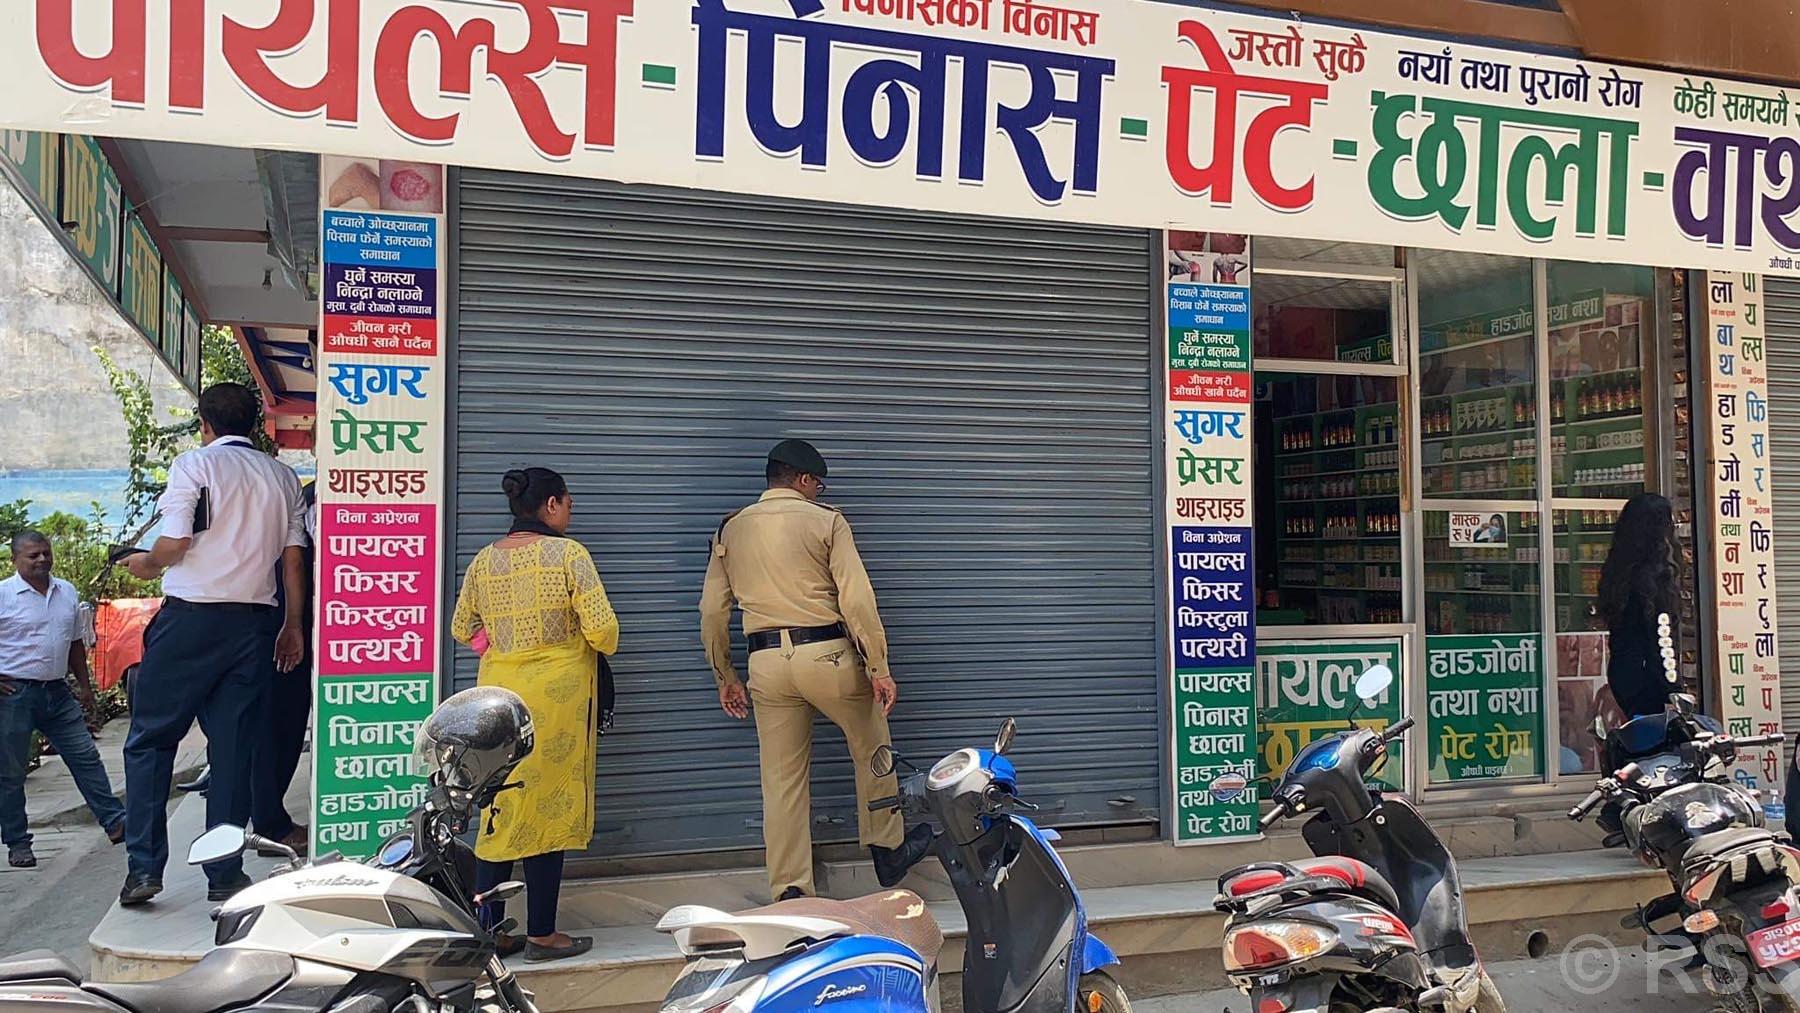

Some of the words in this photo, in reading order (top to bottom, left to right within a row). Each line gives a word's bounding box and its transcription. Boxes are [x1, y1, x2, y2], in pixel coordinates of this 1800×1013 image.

[1003, 0, 1100, 46] विनास
[1228, 26, 1304, 67] जस्तो
[1313, 33, 1367, 80] सुकै
[1398, 46, 1452, 85] नयाँ
[1460, 58, 1511, 93] तथा
[1519, 64, 1590, 105] पुरानो
[1599, 68, 1643, 108] रोग
[1673, 78, 1716, 119] केही
[1722, 89, 1789, 126] समयमै
[36, 0, 633, 158] पायल्स
[692, 0, 1116, 201] पिनास
[1161, 20, 1329, 208] पेट
[1367, 90, 1640, 239] छाला
[360, 248, 400, 261] समाधान
[384, 235, 433, 248] समस्याको
[370, 271, 415, 286] समस्या
[377, 285, 423, 301] नलाग्ने
[367, 302, 395, 313] रोगको
[398, 304, 432, 315] समाधान
[1572, 297, 1600, 318] नशा
[350, 319, 384, 334] जीवन
[388, 322, 412, 335] भरी
[1202, 332, 1234, 345] समस्या
[1716, 325, 1735, 376] बाथ
[327, 363, 430, 405] सुगर
[330, 408, 428, 456] प्रेसर
[1173, 409, 1246, 444] सुगर
[1745, 391, 1767, 492] फिसर
[1176, 447, 1245, 487] प्रेसर
[328, 469, 428, 498] थाइराइड
[1176, 497, 1246, 522] थाइराइड
[1452, 514, 1480, 527] मास्क
[1720, 523, 1741, 537] तथा
[328, 535, 427, 557] पायल्स
[1178, 552, 1246, 571] पायल्स
[1722, 542, 1744, 596] नशा
[333, 564, 421, 594] फिसर
[1182, 576, 1243, 601] फिसर
[325, 600, 427, 630] फिस्टुला
[1177, 606, 1248, 631] फिस्टुला
[328, 631, 424, 664] पत्थरी
[1180, 632, 1247, 658] पत्थरी
[1429, 639, 1537, 678] हाडजोर्नी
[322, 679, 429, 705] पायल्स
[1178, 672, 1252, 693] पायल्स
[1184, 701, 1249, 728] पिनास
[1429, 689, 1480, 718] तथा
[1487, 687, 1538, 716] नशा
[1189, 734, 1246, 755] छाला
[1440, 725, 1477, 760] पेट
[1484, 723, 1531, 760] रोग
[334, 754, 414, 780] छाला
[1180, 791, 1214, 809] तथा
[319, 821, 370, 844] तथा
[1187, 813, 1213, 834] पेट
[1218, 811, 1252, 833] रोग
